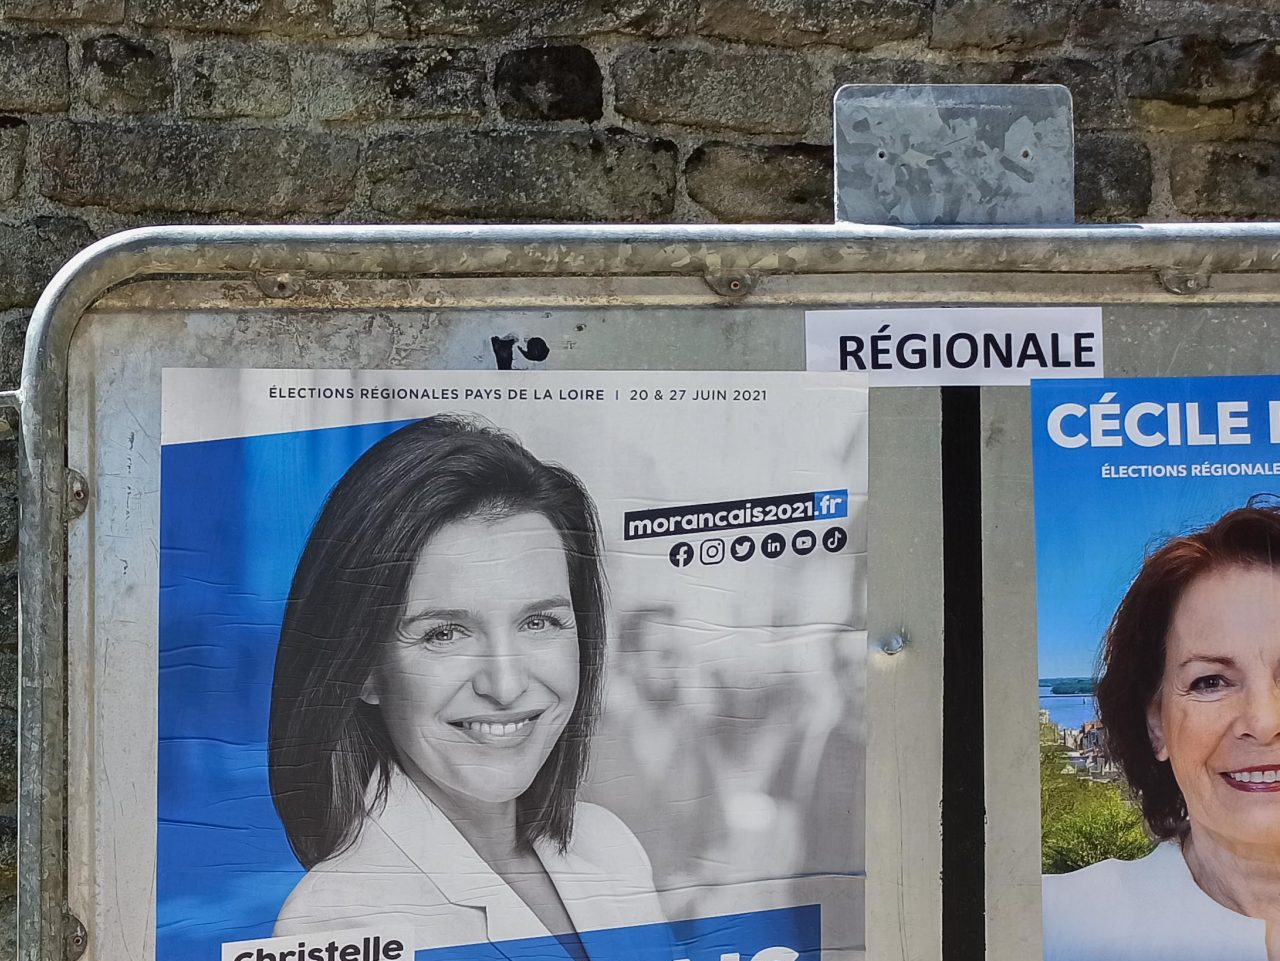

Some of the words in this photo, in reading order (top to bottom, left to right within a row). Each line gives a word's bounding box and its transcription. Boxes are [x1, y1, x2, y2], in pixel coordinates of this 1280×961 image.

[839, 325, 1095, 371] RÉGIONALE
[269, 384, 354, 401] ÉLECTIONS
[360, 385, 459, 401] RÉGIONALES
[465, 389, 501, 401] PAYS
[506, 389, 528, 401] DE
[532, 390, 553, 401] LA
[559, 390, 605, 401] LOIRE
[630, 390, 649, 401] 20
[654, 390, 665, 401] &
[670, 390, 687, 401] 27
[692, 390, 727, 401] JUIN
[733, 390, 767, 401] 2021
[1047, 393, 1251, 449] CÉCILE
[1101, 464, 1187, 478] ÉLECTIONS
[629, 495, 842, 535] morancais2021.fr
